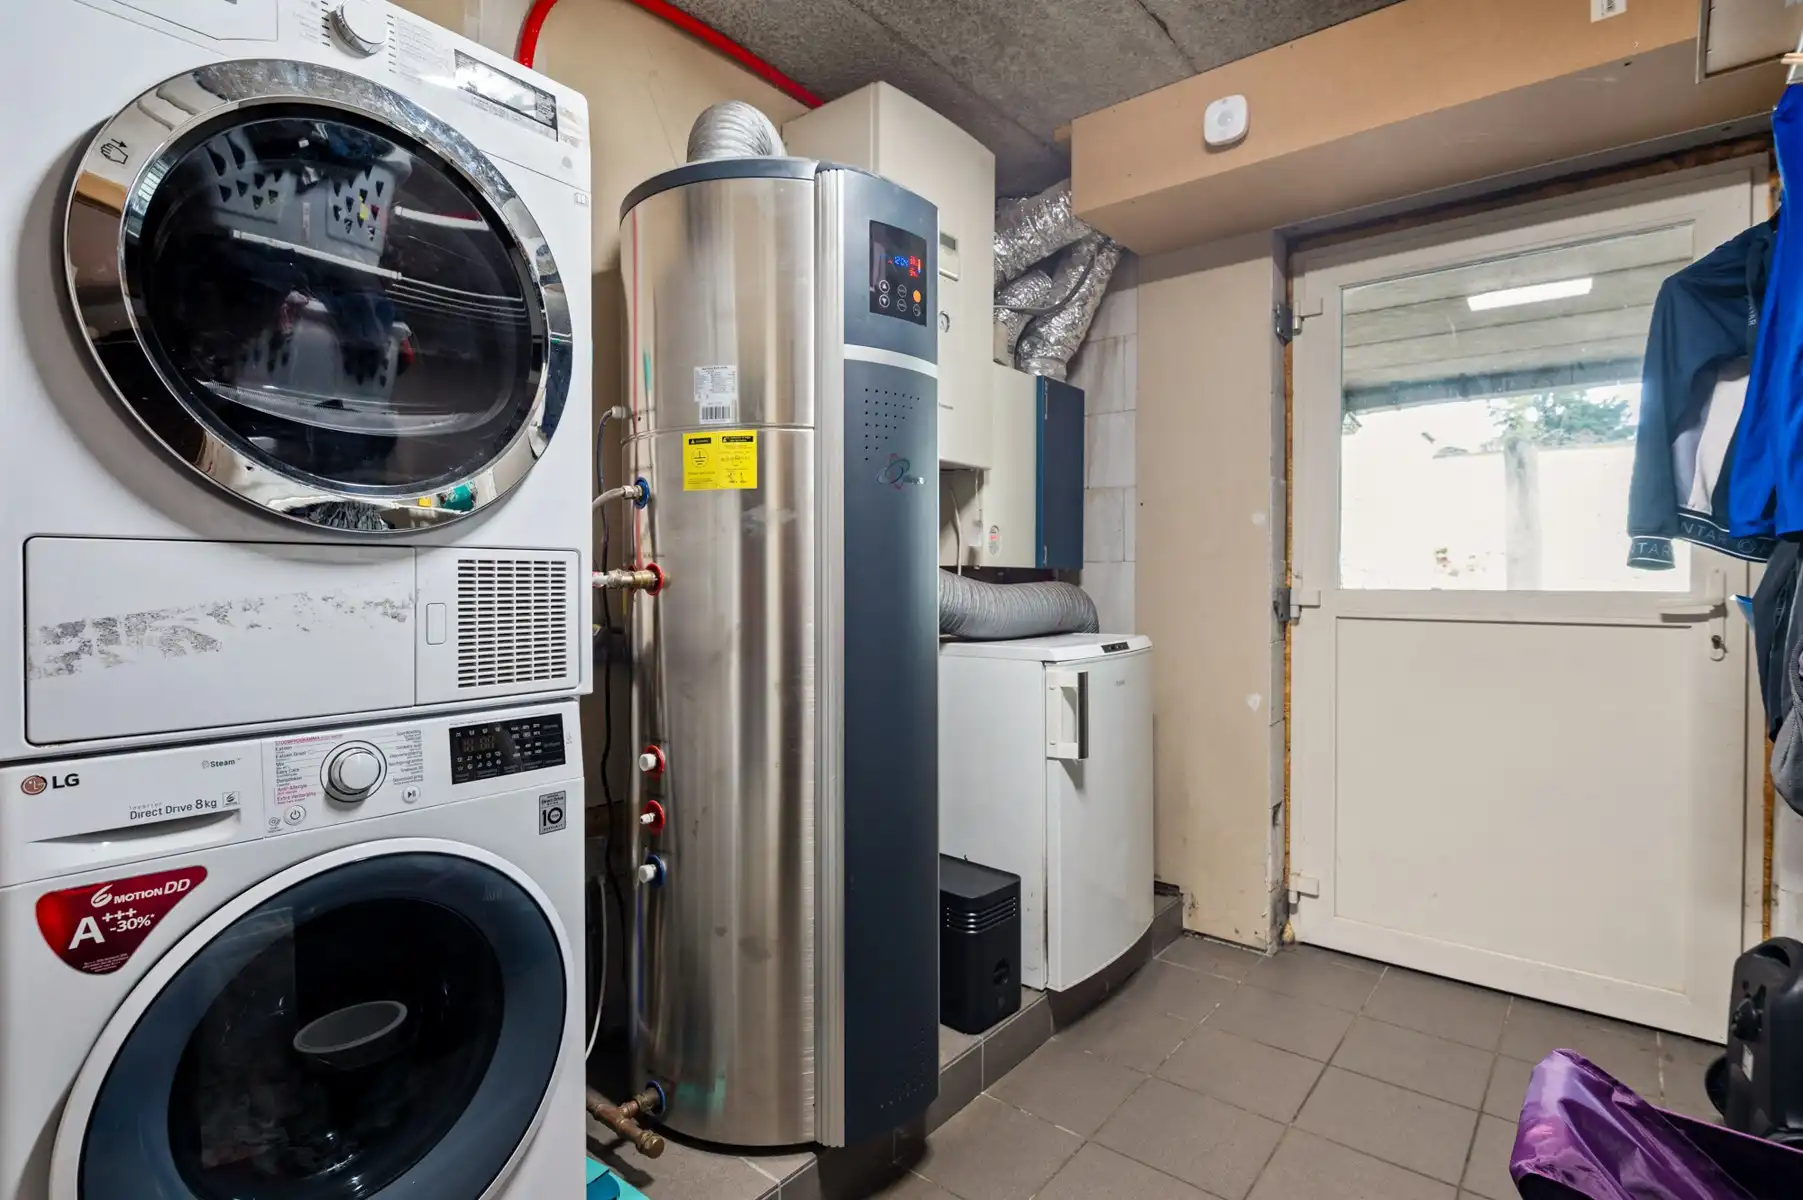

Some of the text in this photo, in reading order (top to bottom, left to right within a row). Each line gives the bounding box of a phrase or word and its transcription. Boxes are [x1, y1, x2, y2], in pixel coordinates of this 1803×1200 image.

[52, 773, 80, 789] LG
[130, 808, 162, 820] Direct
[165, 803, 193, 814] Drive
[113, 888, 163, 904] MOTION
[164, 878, 191, 895] DD
